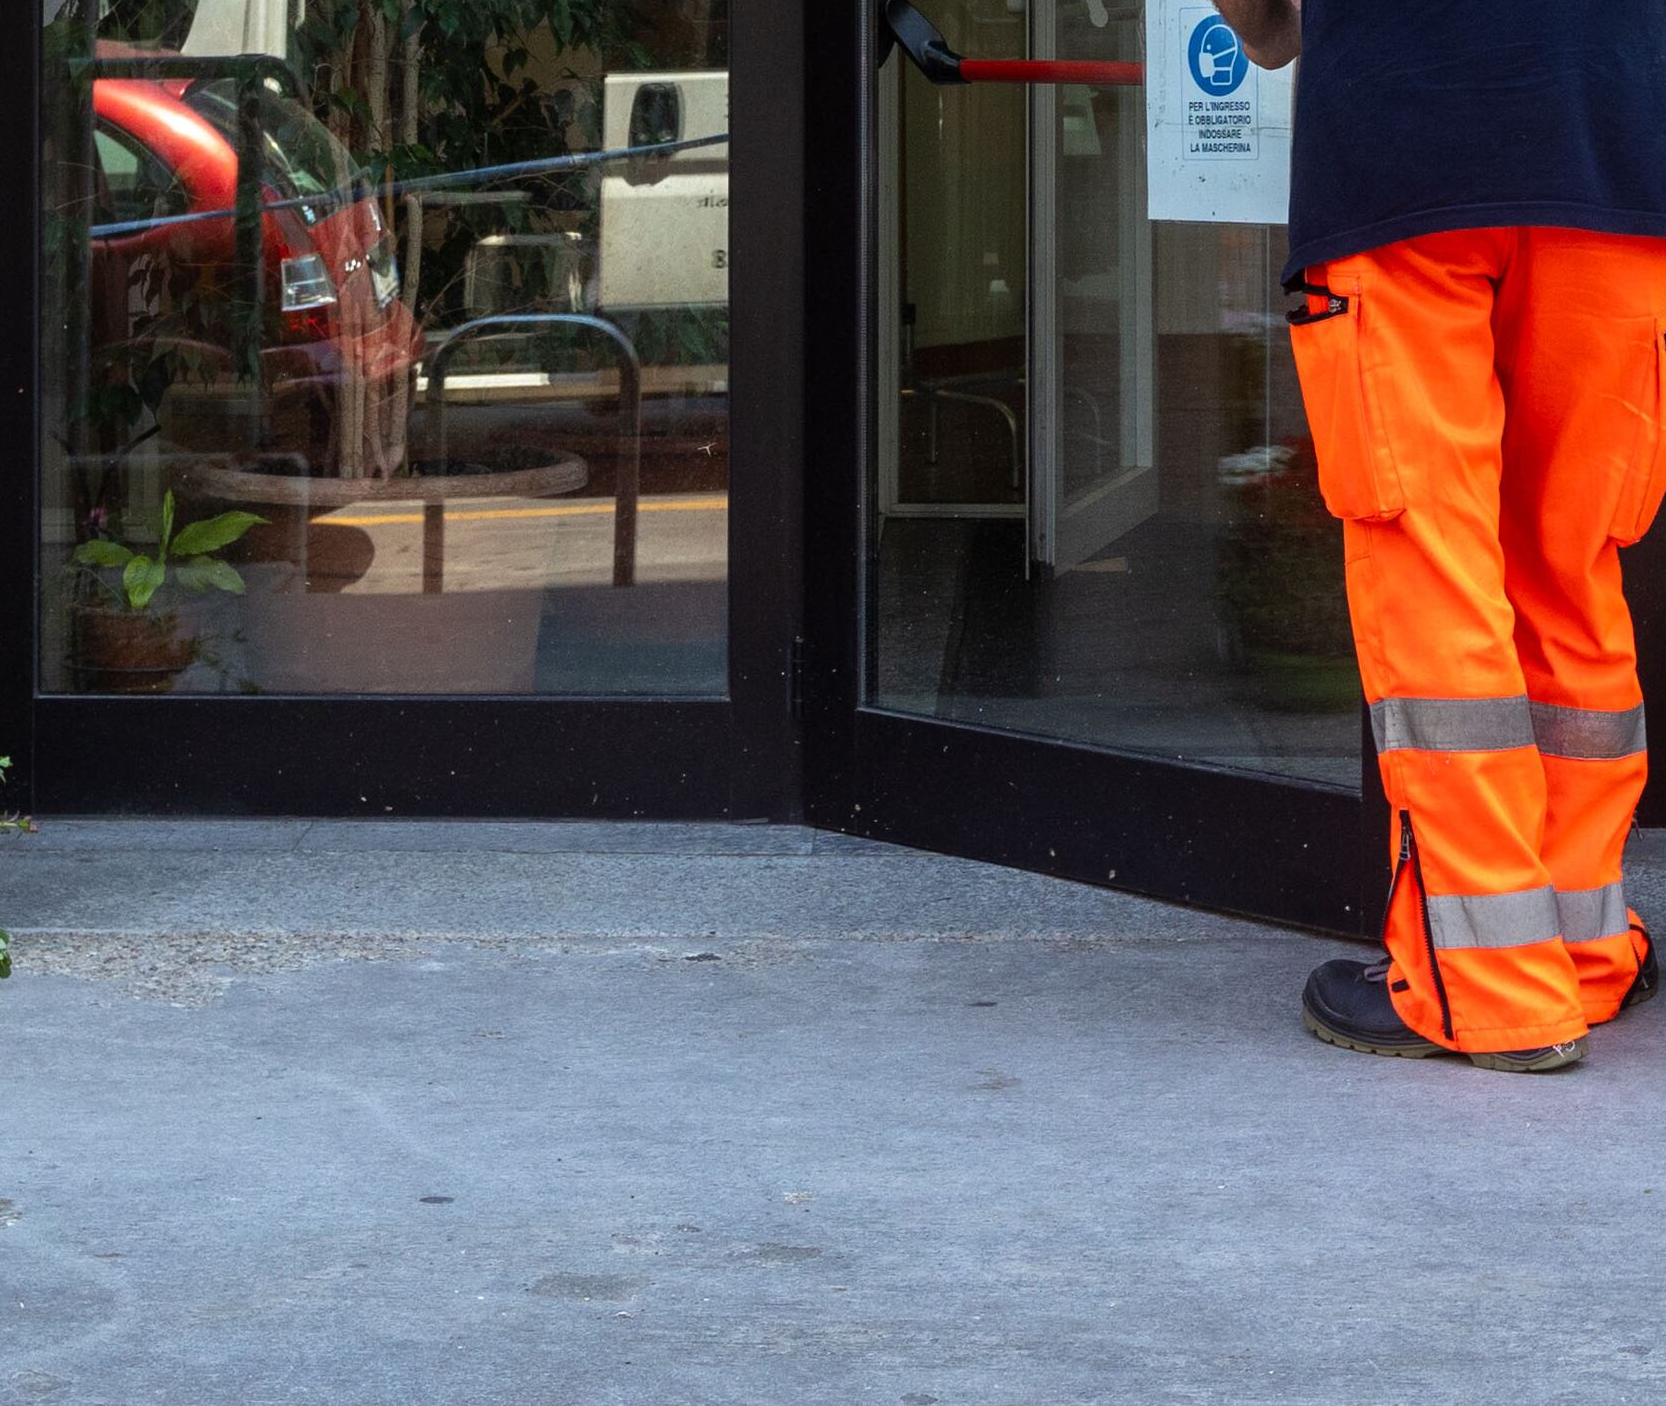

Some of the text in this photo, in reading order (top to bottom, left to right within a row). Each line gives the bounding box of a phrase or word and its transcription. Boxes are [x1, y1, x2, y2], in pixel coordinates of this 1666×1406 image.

[1188, 101, 1251, 112] PER L'INGRESSO
[1194, 114, 1252, 125] OBBLIGATORIO
[1198, 129, 1242, 139] INDOSSARE
[1190, 142, 1252, 153] LA MASCHERINA
